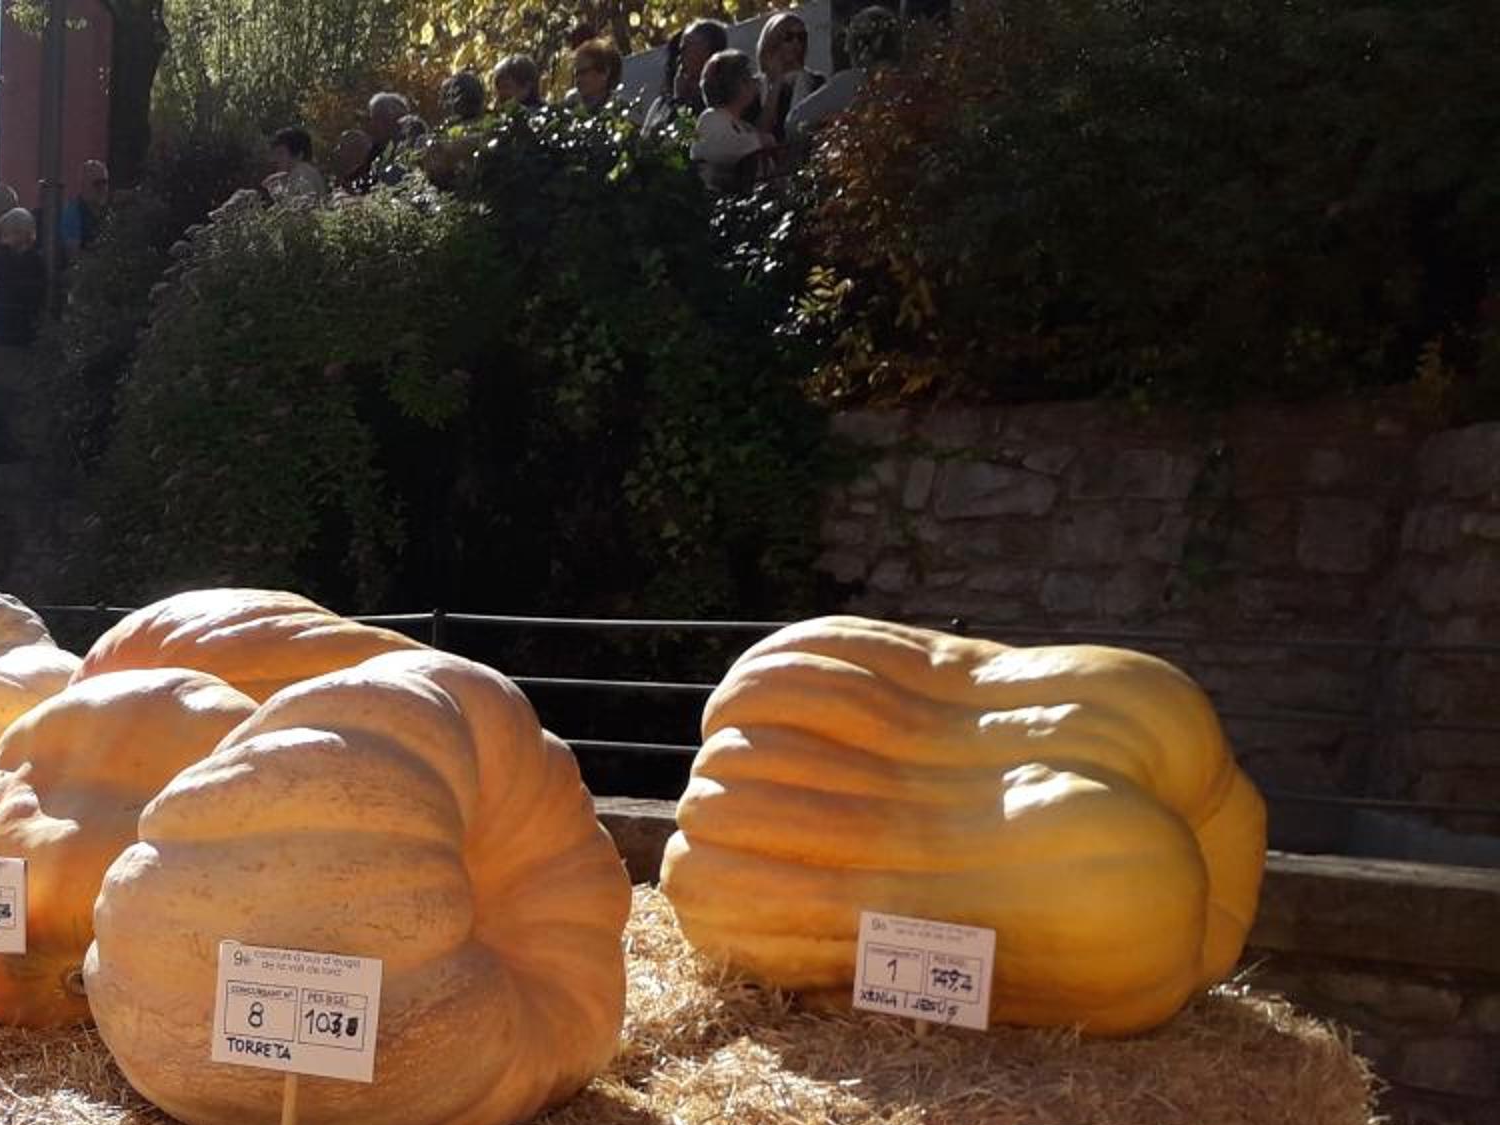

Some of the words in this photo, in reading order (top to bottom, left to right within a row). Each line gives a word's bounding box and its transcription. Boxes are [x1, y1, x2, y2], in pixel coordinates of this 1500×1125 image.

[887, 959, 897, 984] 1
[248, 1001, 265, 1029] 8
[227, 1037, 292, 1060] TORRETA
